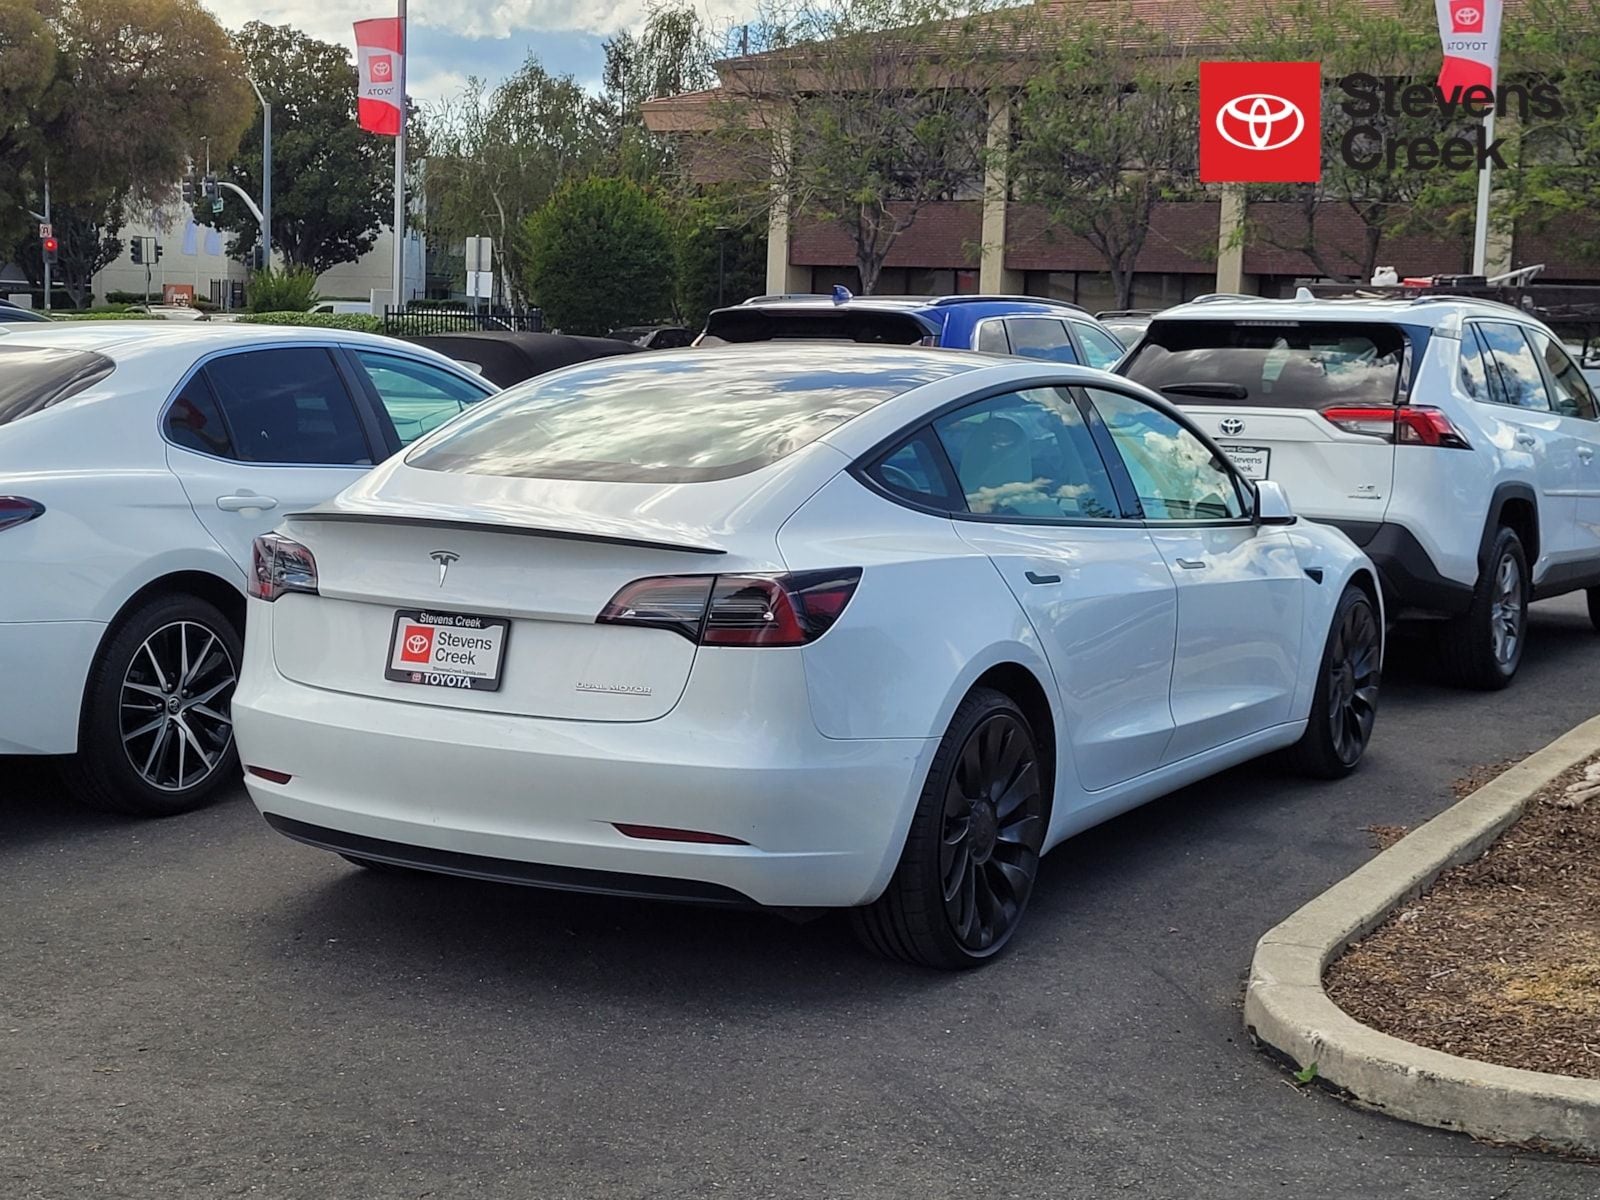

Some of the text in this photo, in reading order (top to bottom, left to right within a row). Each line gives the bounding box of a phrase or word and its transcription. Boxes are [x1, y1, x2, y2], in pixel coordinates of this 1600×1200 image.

[420, 612, 482, 628] Stevens Creek
[438, 631, 492, 650] Stevens
[435, 647, 476, 666] Creek
[423, 672, 471, 688] TOYOTA
[576, 682, 652, 694] DUAL MOTOR
